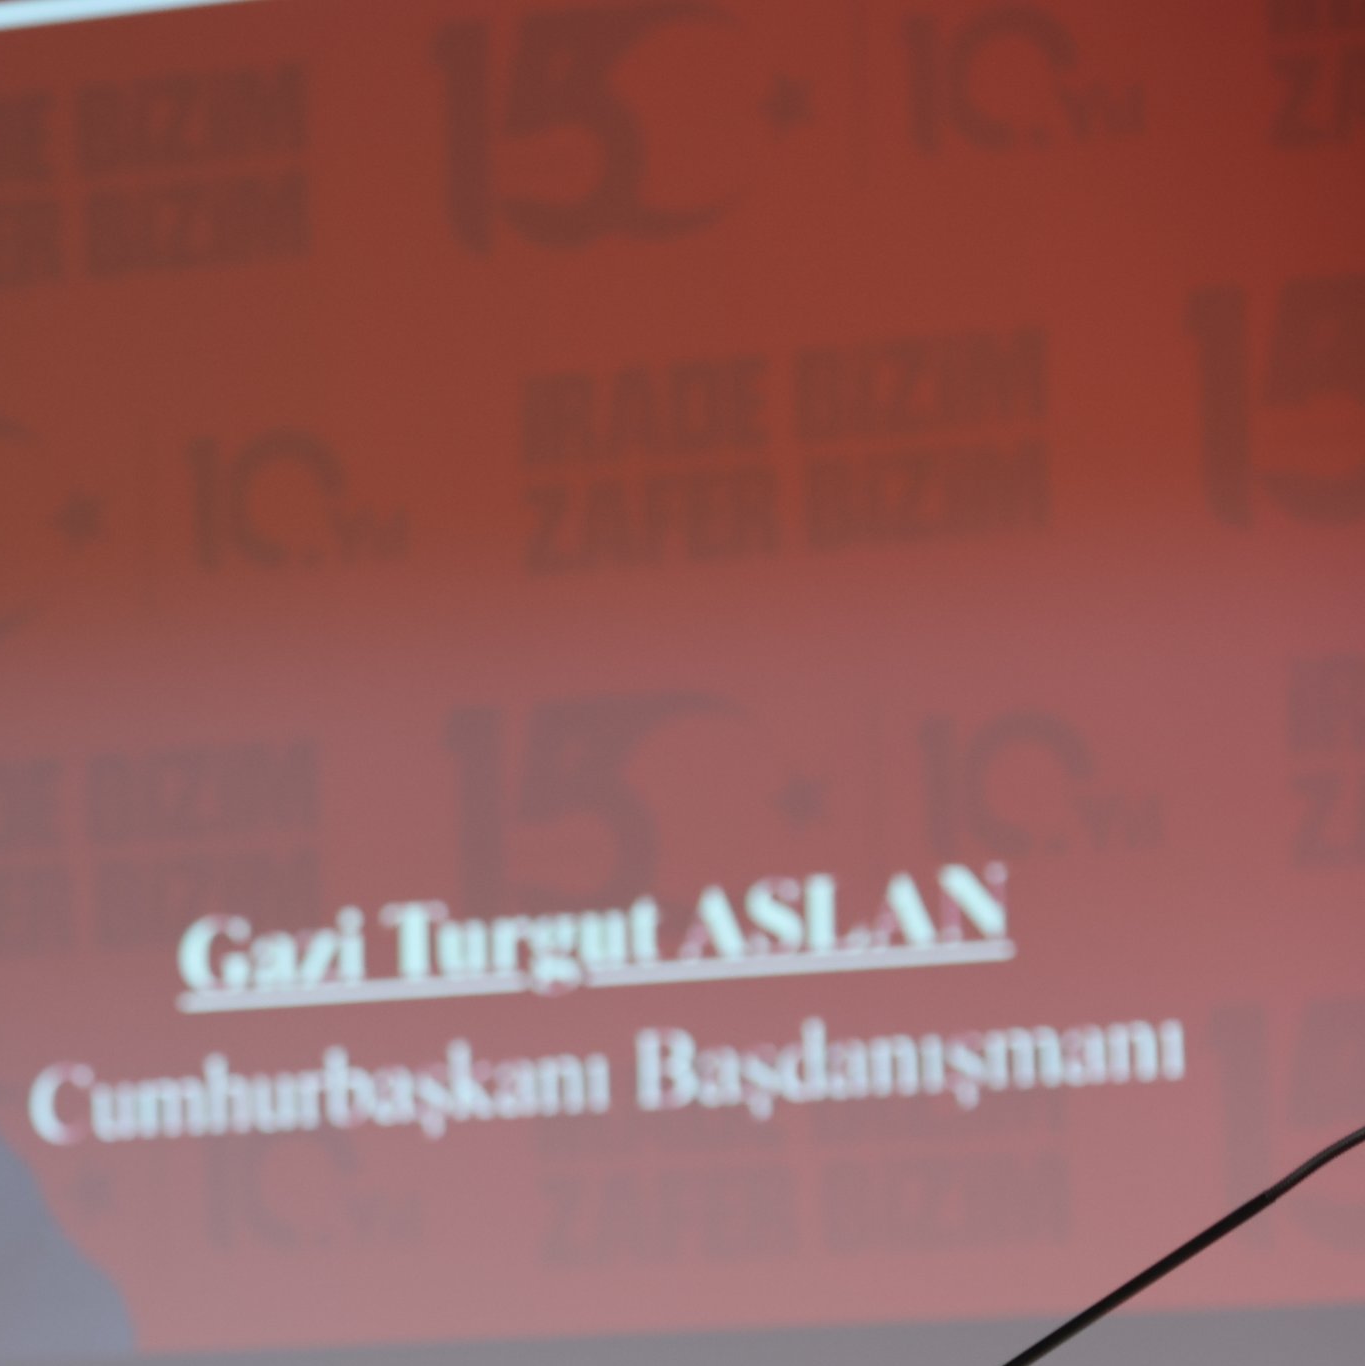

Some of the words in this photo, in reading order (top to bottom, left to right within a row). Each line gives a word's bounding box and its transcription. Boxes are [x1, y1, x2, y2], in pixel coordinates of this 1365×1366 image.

[176, 904, 368, 993] Gazi
[377, 896, 662, 997] Turgut
[678, 861, 1010, 961] ASLAN
[29, 1037, 611, 1145] Cumhurbaşkanı
[635, 1016, 1185, 1120] Başdanışmanı
